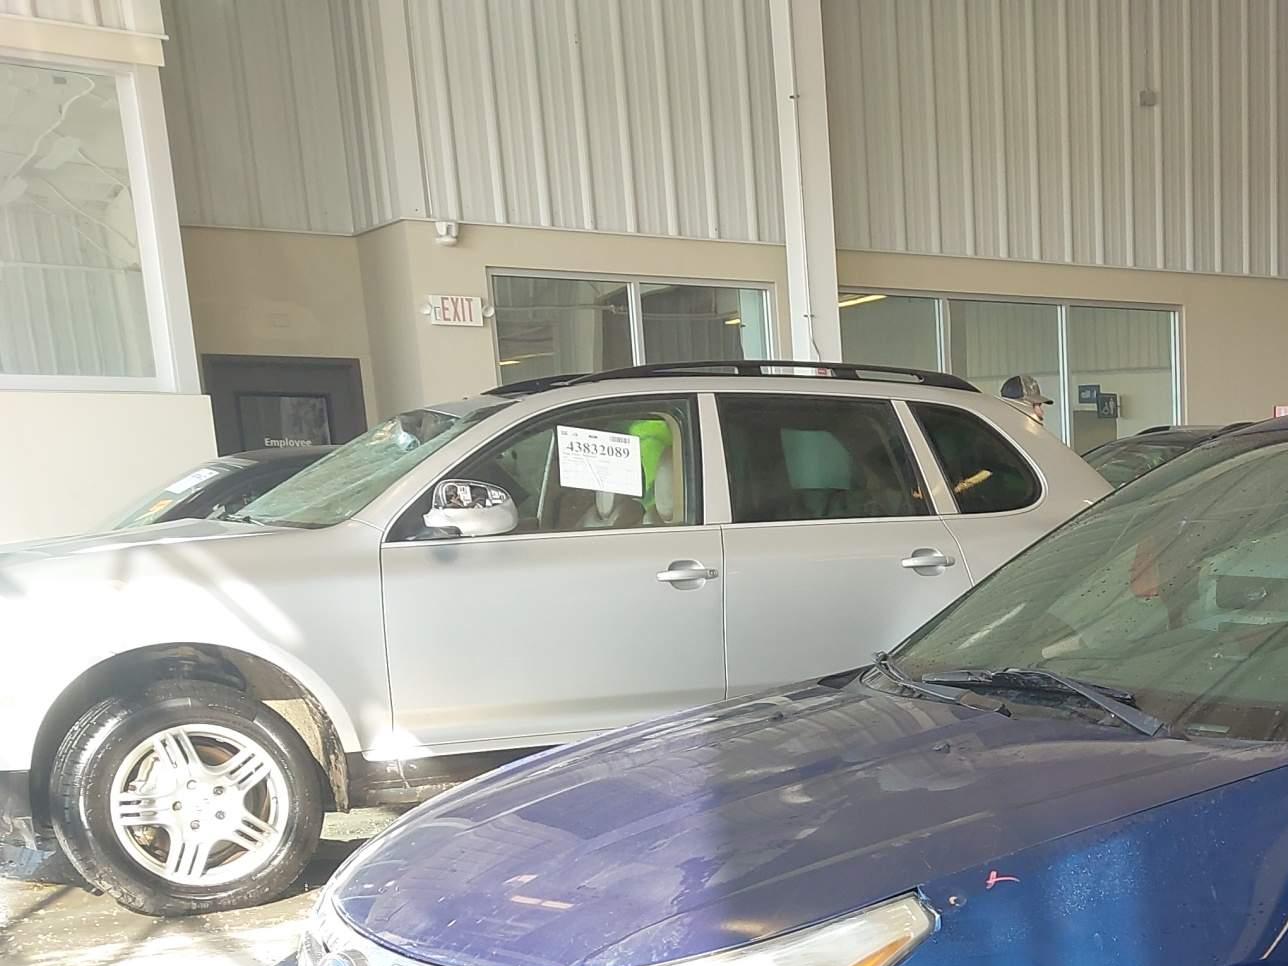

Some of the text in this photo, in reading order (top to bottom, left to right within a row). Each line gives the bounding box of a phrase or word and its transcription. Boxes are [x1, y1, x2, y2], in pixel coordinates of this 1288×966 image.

[440, 296, 473, 322] EXIT
[264, 437, 313, 448] Employee
[566, 441, 630, 458] 43832089
